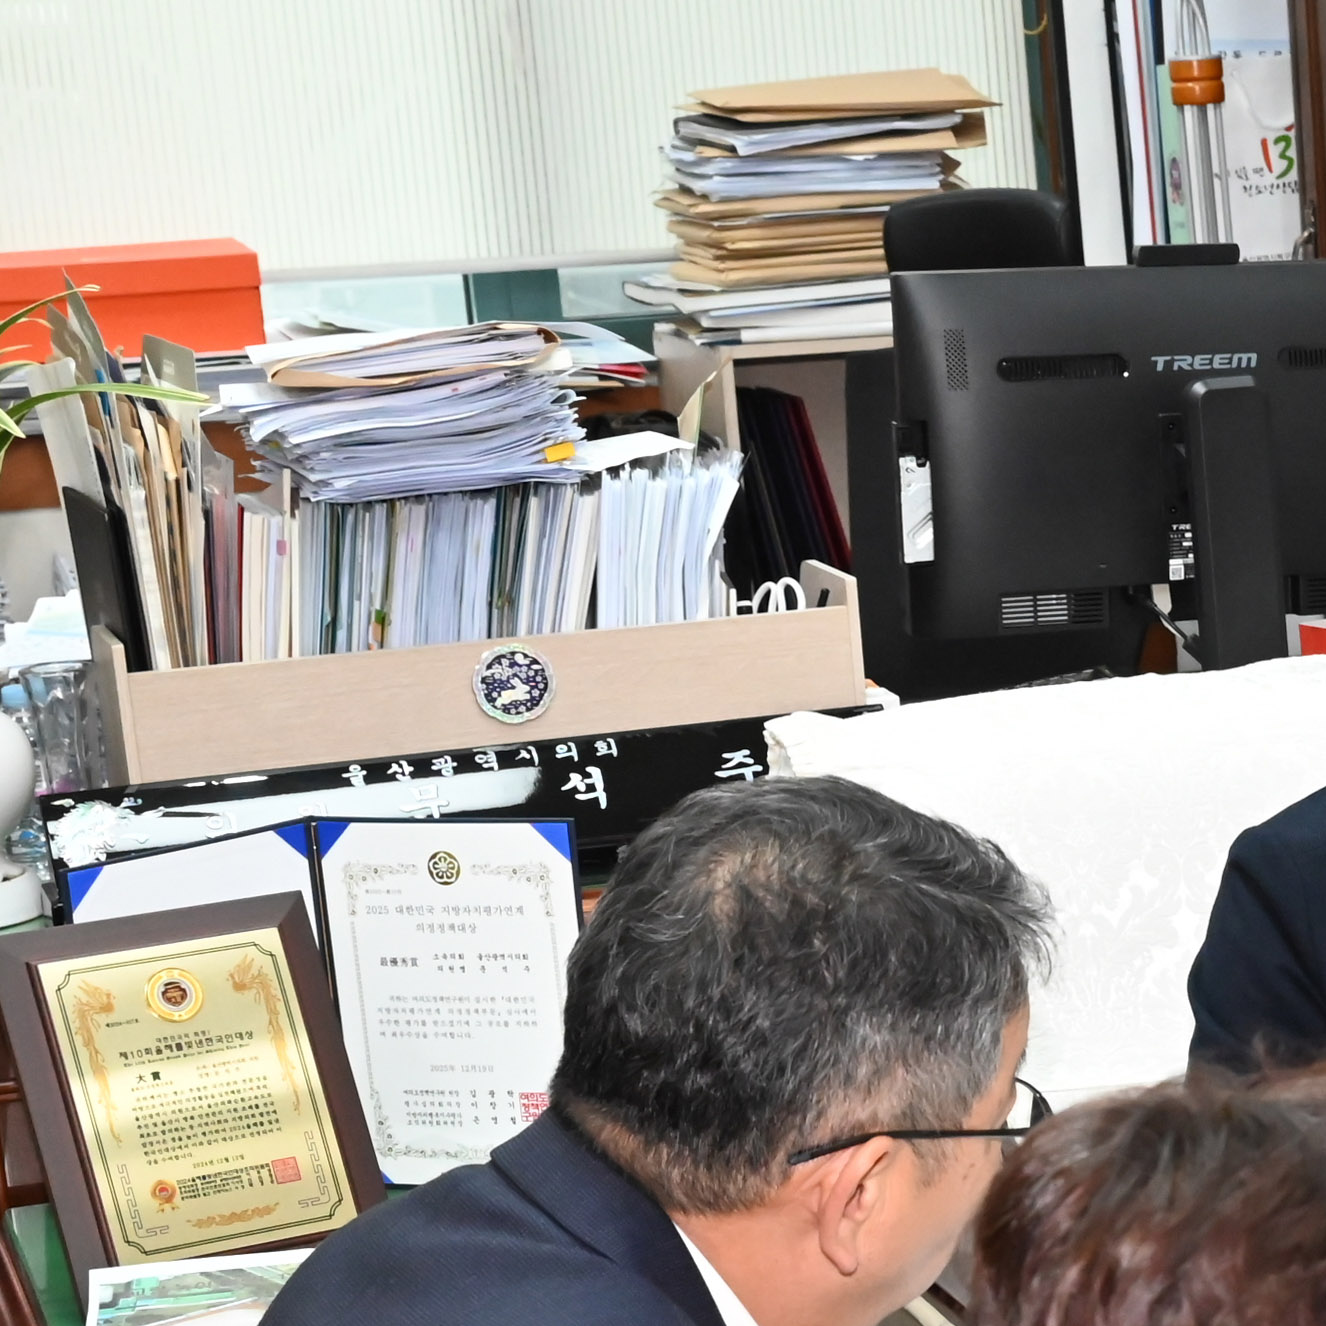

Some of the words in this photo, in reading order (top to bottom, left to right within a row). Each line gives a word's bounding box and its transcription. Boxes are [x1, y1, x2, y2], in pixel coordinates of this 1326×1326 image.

[1151, 353, 1257, 371] TREEM
[341, 737, 619, 788] 울산광역시의회
[366, 906, 389, 915] 2025
[396, 905, 434, 916] 대한민국
[416, 923, 477, 934] 의정정책대상
